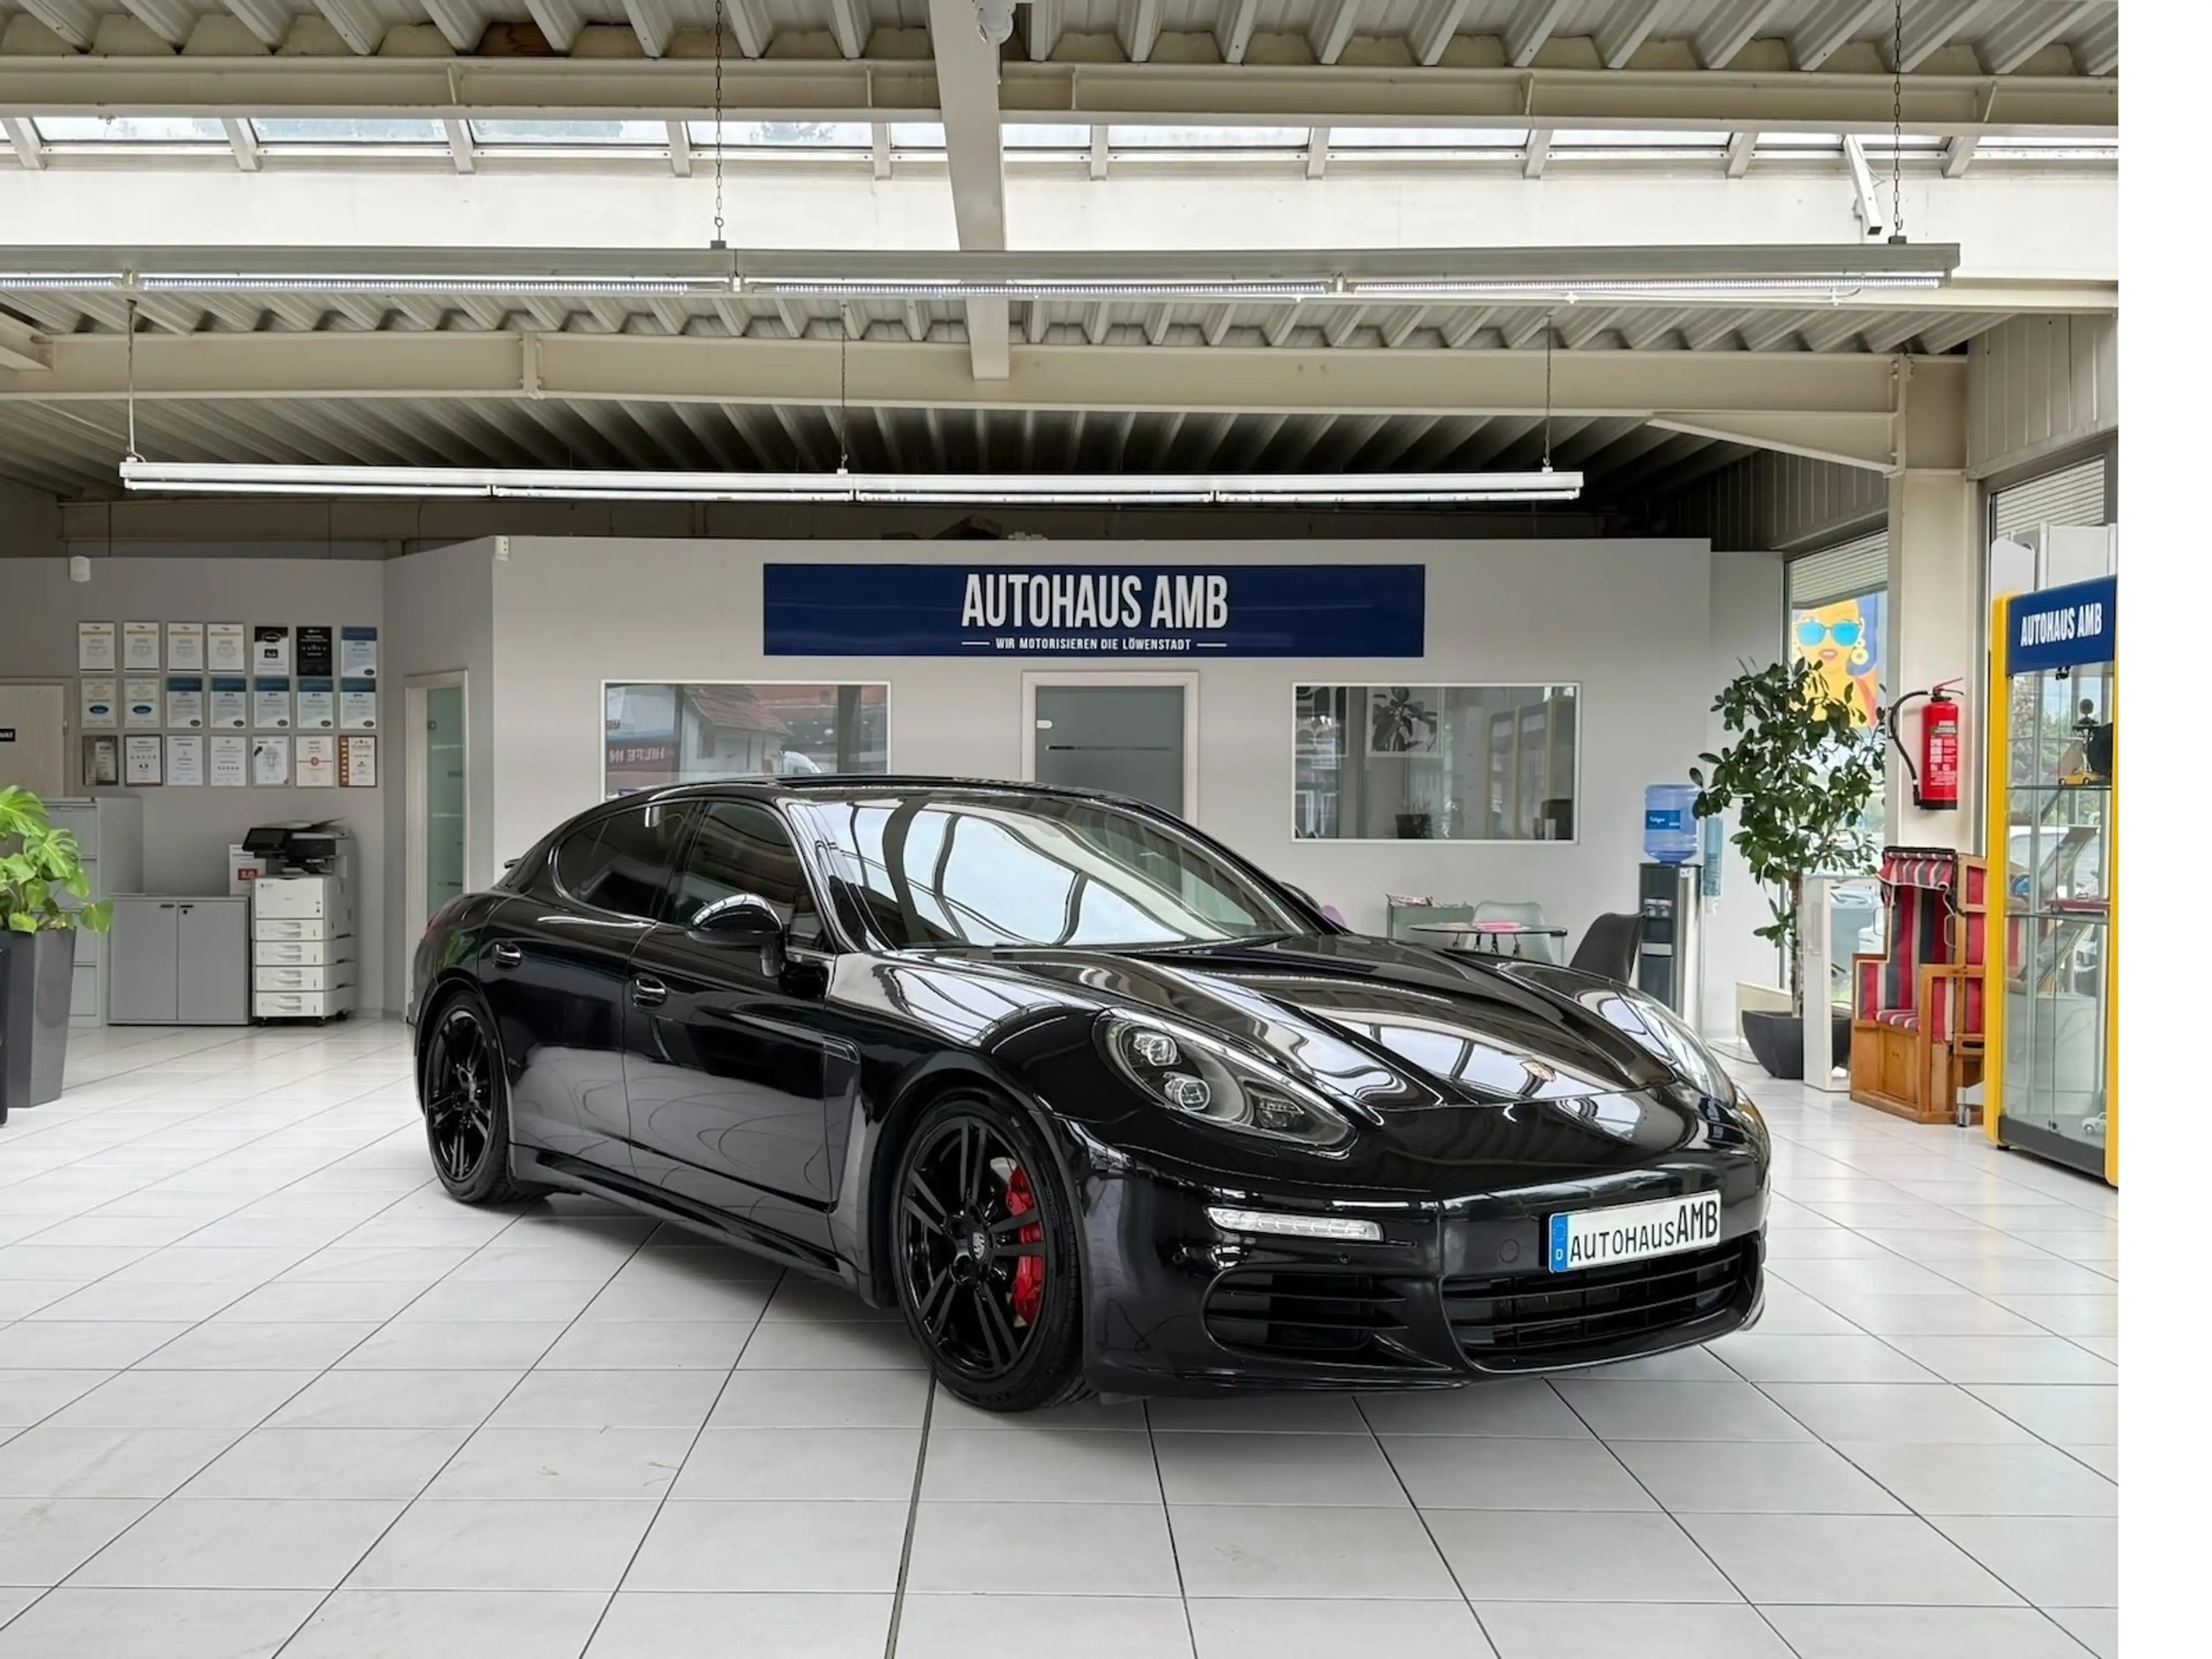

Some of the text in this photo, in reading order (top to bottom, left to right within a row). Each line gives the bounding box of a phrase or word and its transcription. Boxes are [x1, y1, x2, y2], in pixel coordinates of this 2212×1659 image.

[961, 574, 1228, 628] AUTOHAUS AMB
[995, 637, 1191, 650] WIR MOTORISIEREN DIE LÖWENSTADT
[2020, 603, 2103, 646] AUTOHAUS AMB
